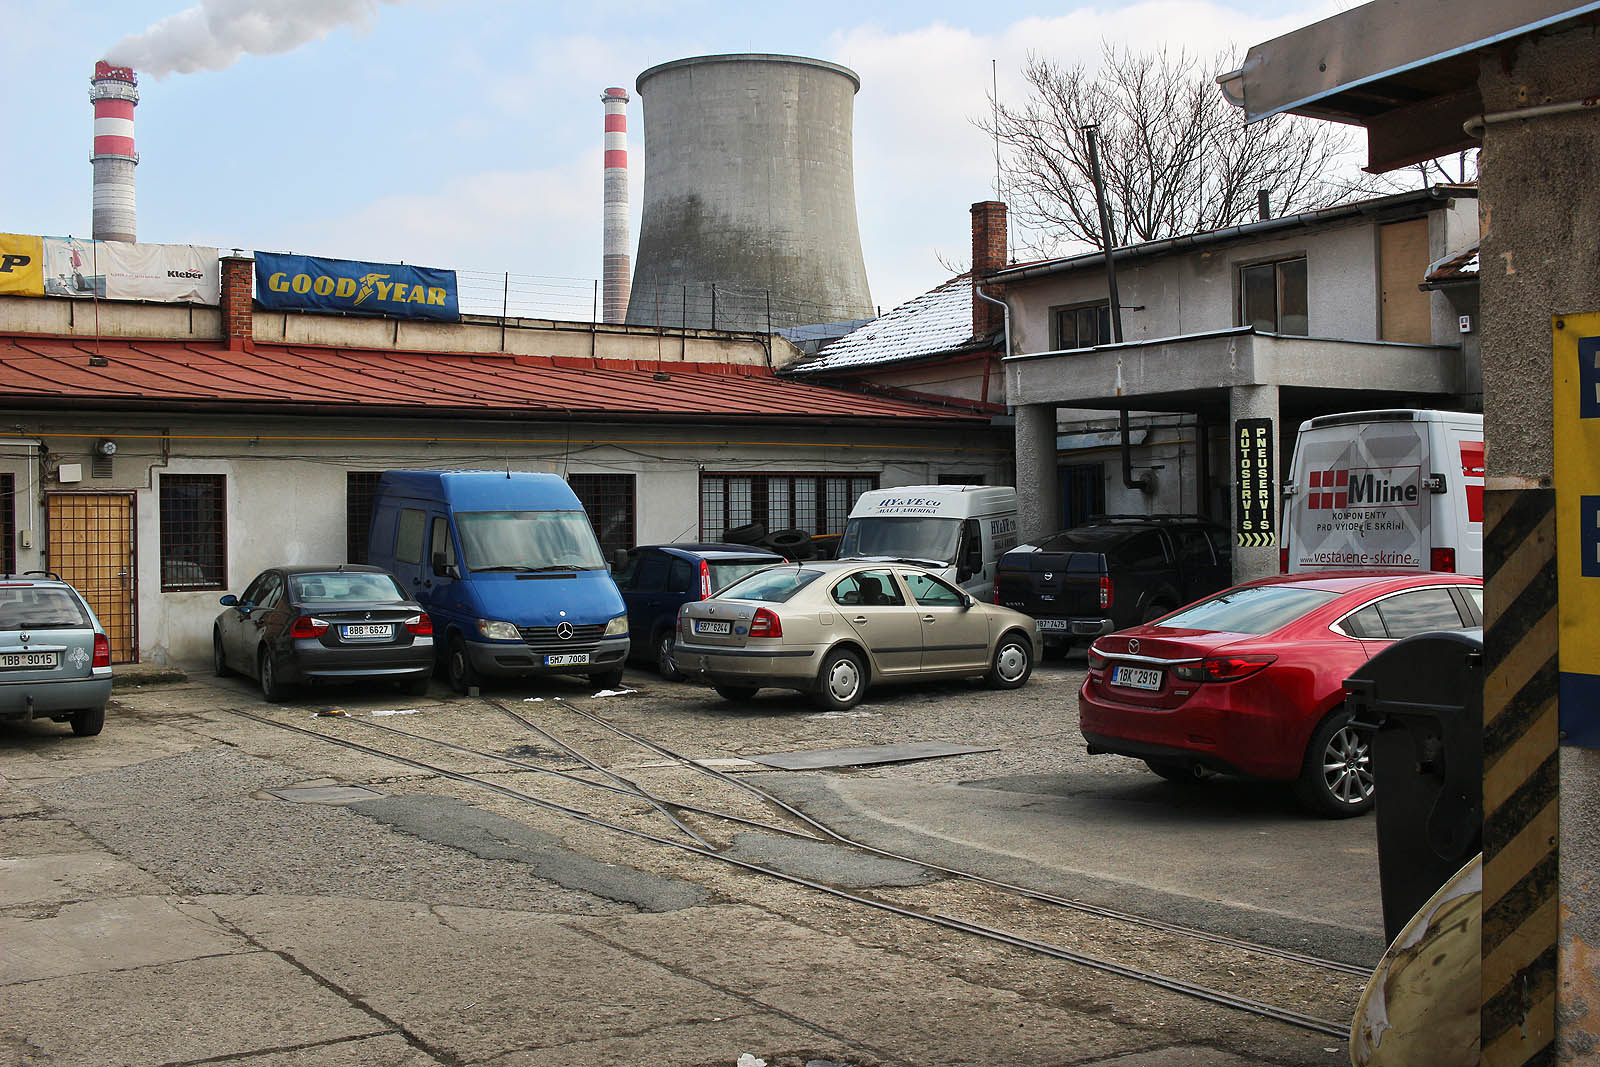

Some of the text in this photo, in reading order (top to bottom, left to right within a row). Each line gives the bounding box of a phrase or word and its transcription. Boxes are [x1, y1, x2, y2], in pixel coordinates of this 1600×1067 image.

[167, 269, 204, 280] Kleber
[1241, 428, 1252, 530] AUTOSERVIS
[1256, 428, 1269, 530] PNEUSERVIS
[1316, 523, 1333, 532] PRO
[370, 625, 388, 634] 6627
[1050, 620, 1065, 628] 7475
[1, 654, 52, 666] 1BB 9015
[568, 654, 587, 664] 7008
[1138, 671, 1158, 685] 2919
